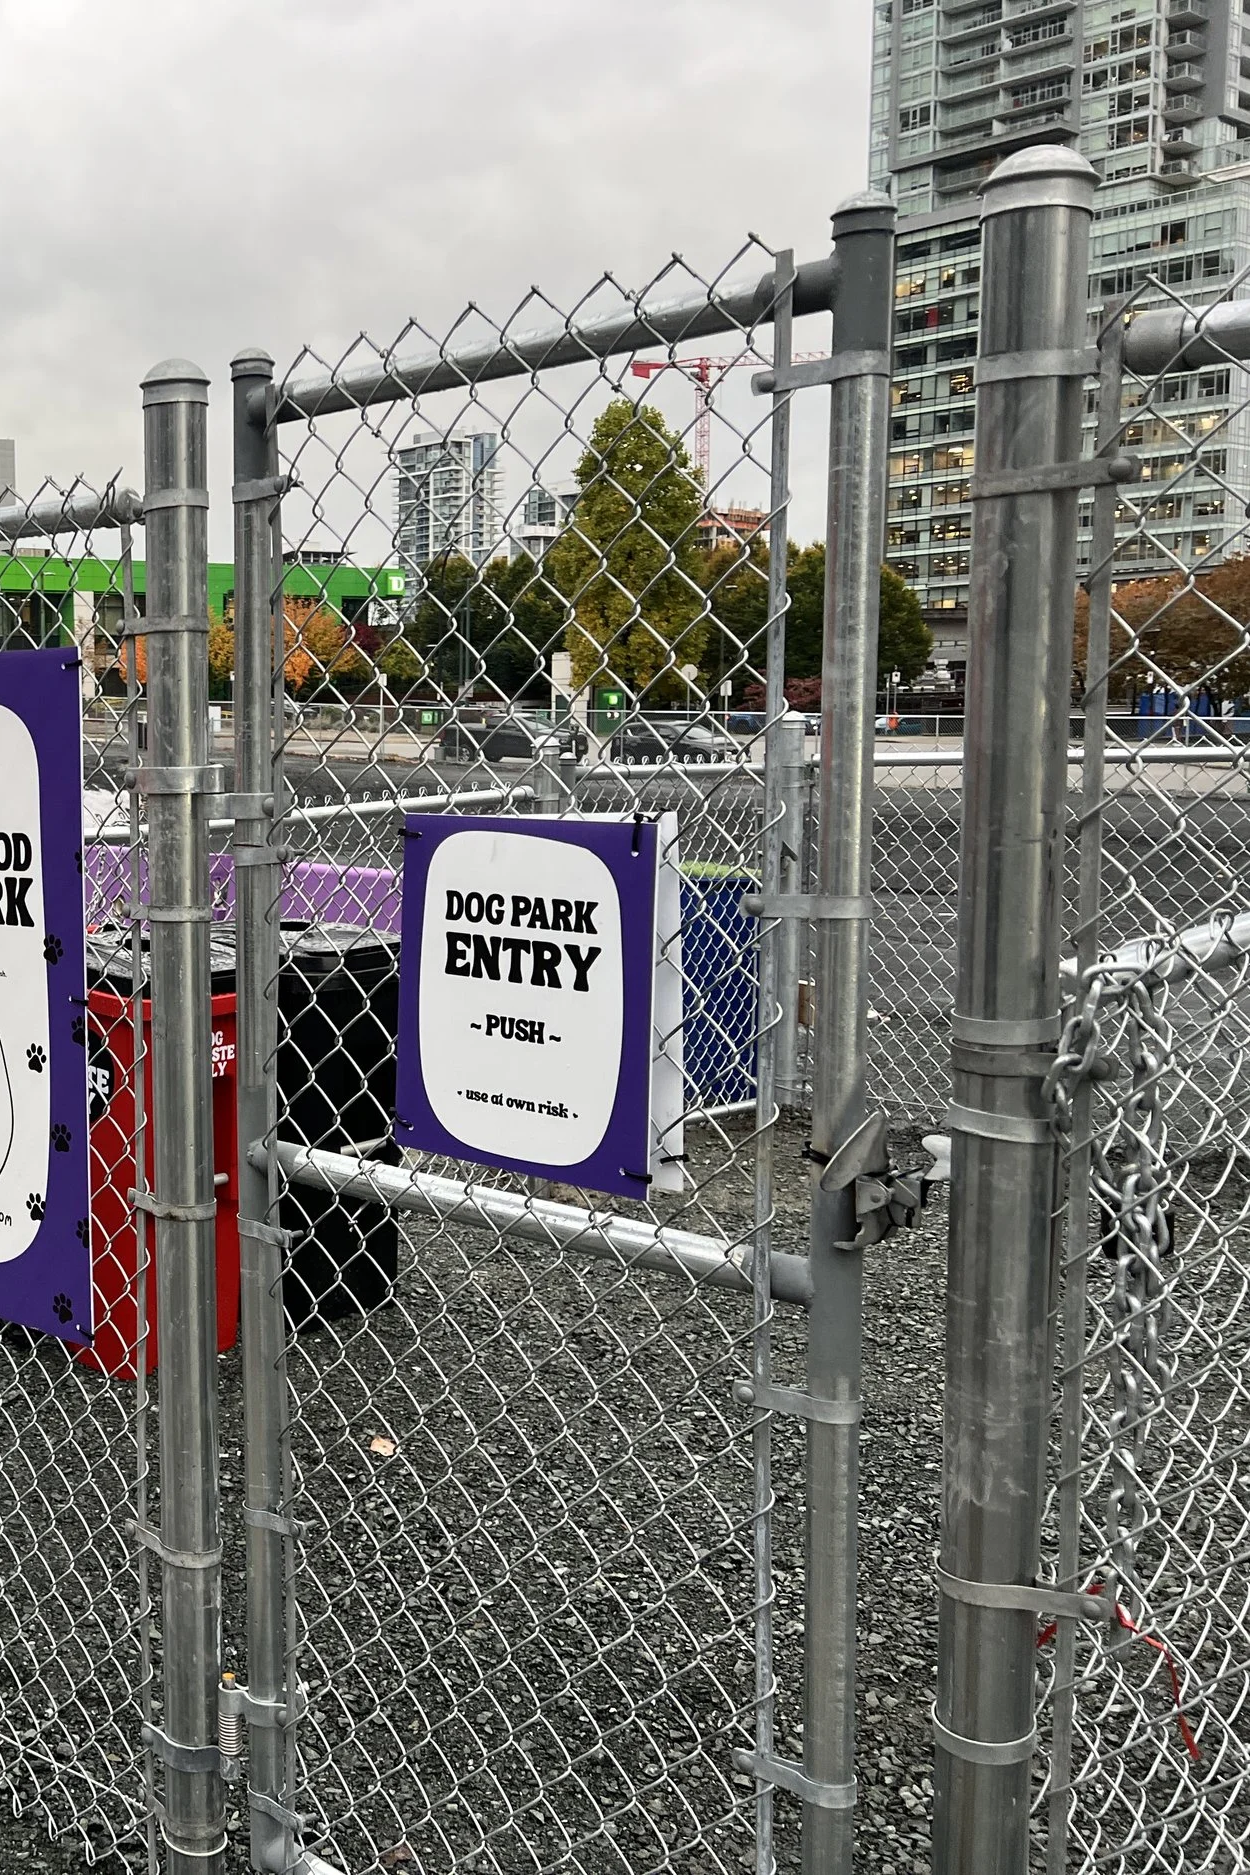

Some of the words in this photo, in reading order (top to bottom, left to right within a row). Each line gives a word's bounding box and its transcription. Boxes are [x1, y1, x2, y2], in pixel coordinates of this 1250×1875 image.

[388, 576, 405, 592] TD
[445, 889, 505, 926] DOG
[510, 895, 599, 935] PARK
[444, 931, 602, 993] ENTRY
[485, 1013, 545, 1045] PUSH
[211, 1044, 235, 1062] STE
[211, 1061, 227, 1078] LY
[465, 1089, 489, 1104] use
[490, 1092, 504, 1107] at
[506, 1097, 535, 1113] own
[537, 1100, 569, 1119] risk
